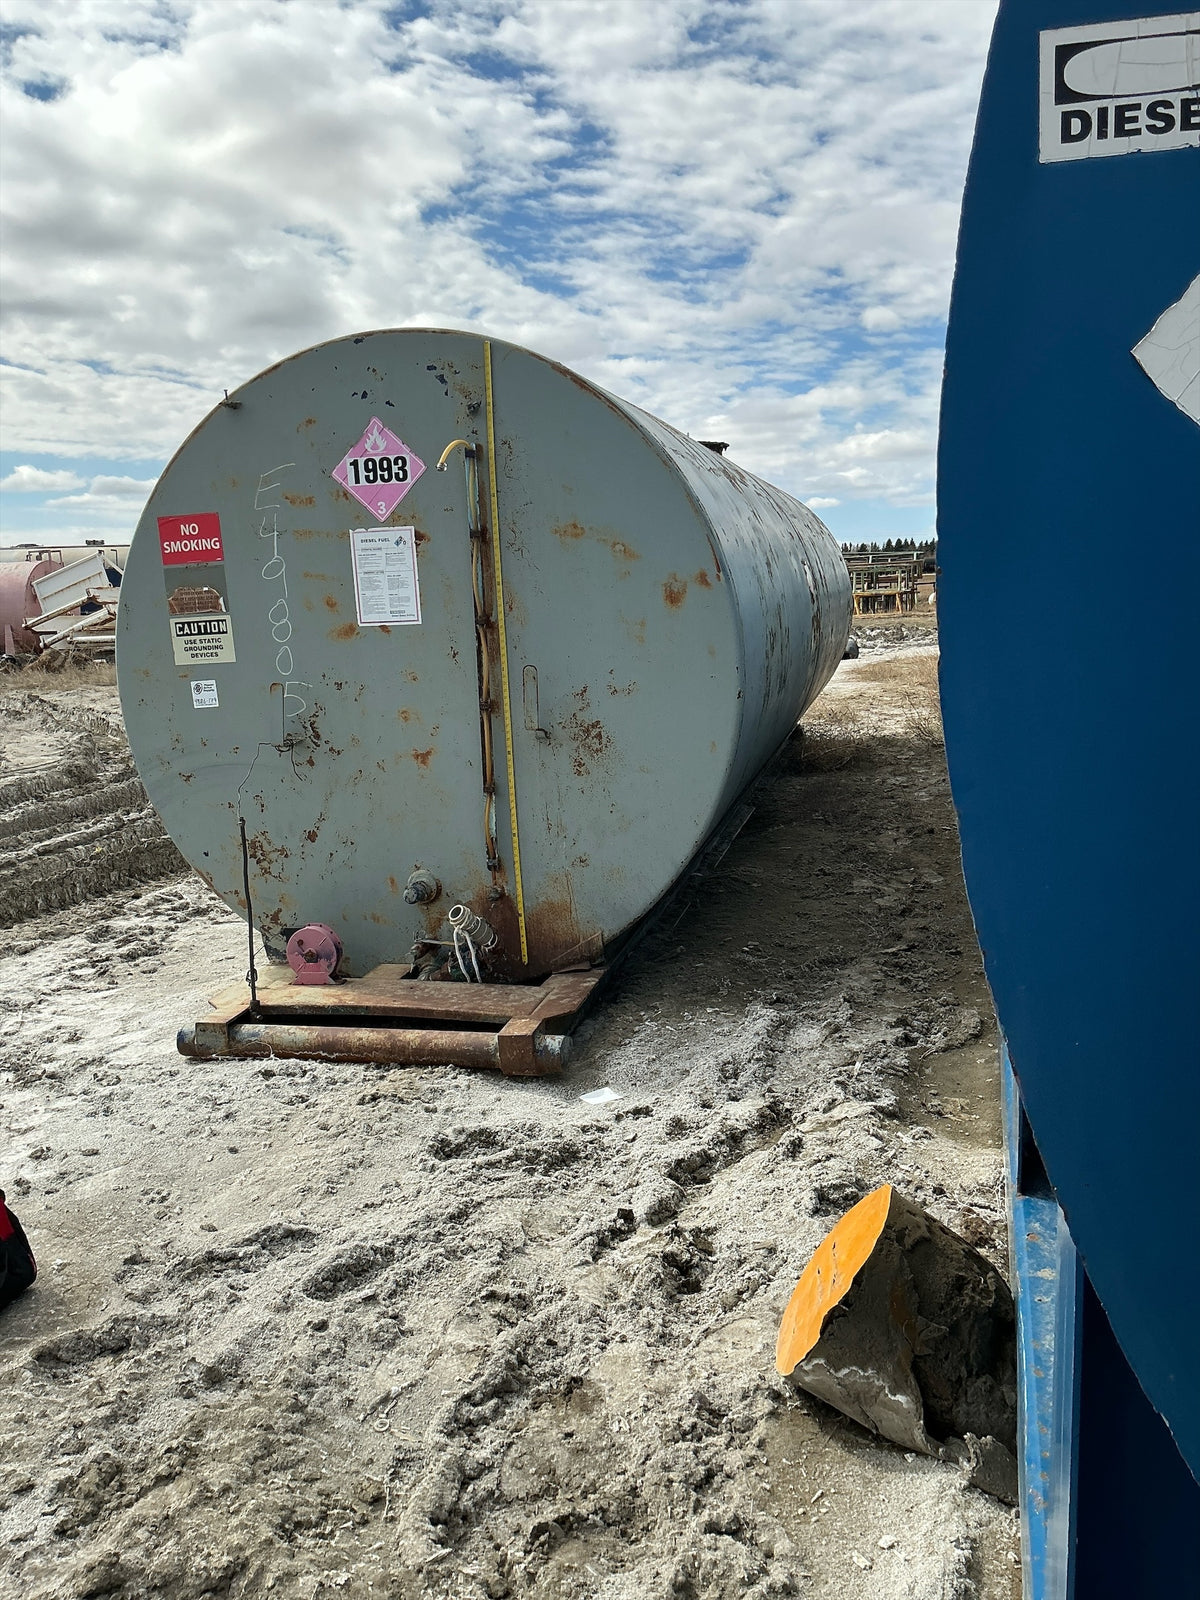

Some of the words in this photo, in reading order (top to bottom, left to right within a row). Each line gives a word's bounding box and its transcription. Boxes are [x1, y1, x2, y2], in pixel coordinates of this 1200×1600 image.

[349, 455, 408, 485] 1993
[377, 501, 387, 514] 3
[180, 523, 199, 536] NO
[163, 537, 220, 554] SMOKING
[175, 620, 227, 635] CAUTION
[198, 637, 222, 645] STATIC
[183, 644, 224, 652] GROUNDING
[190, 651, 219, 659] DEVICES
